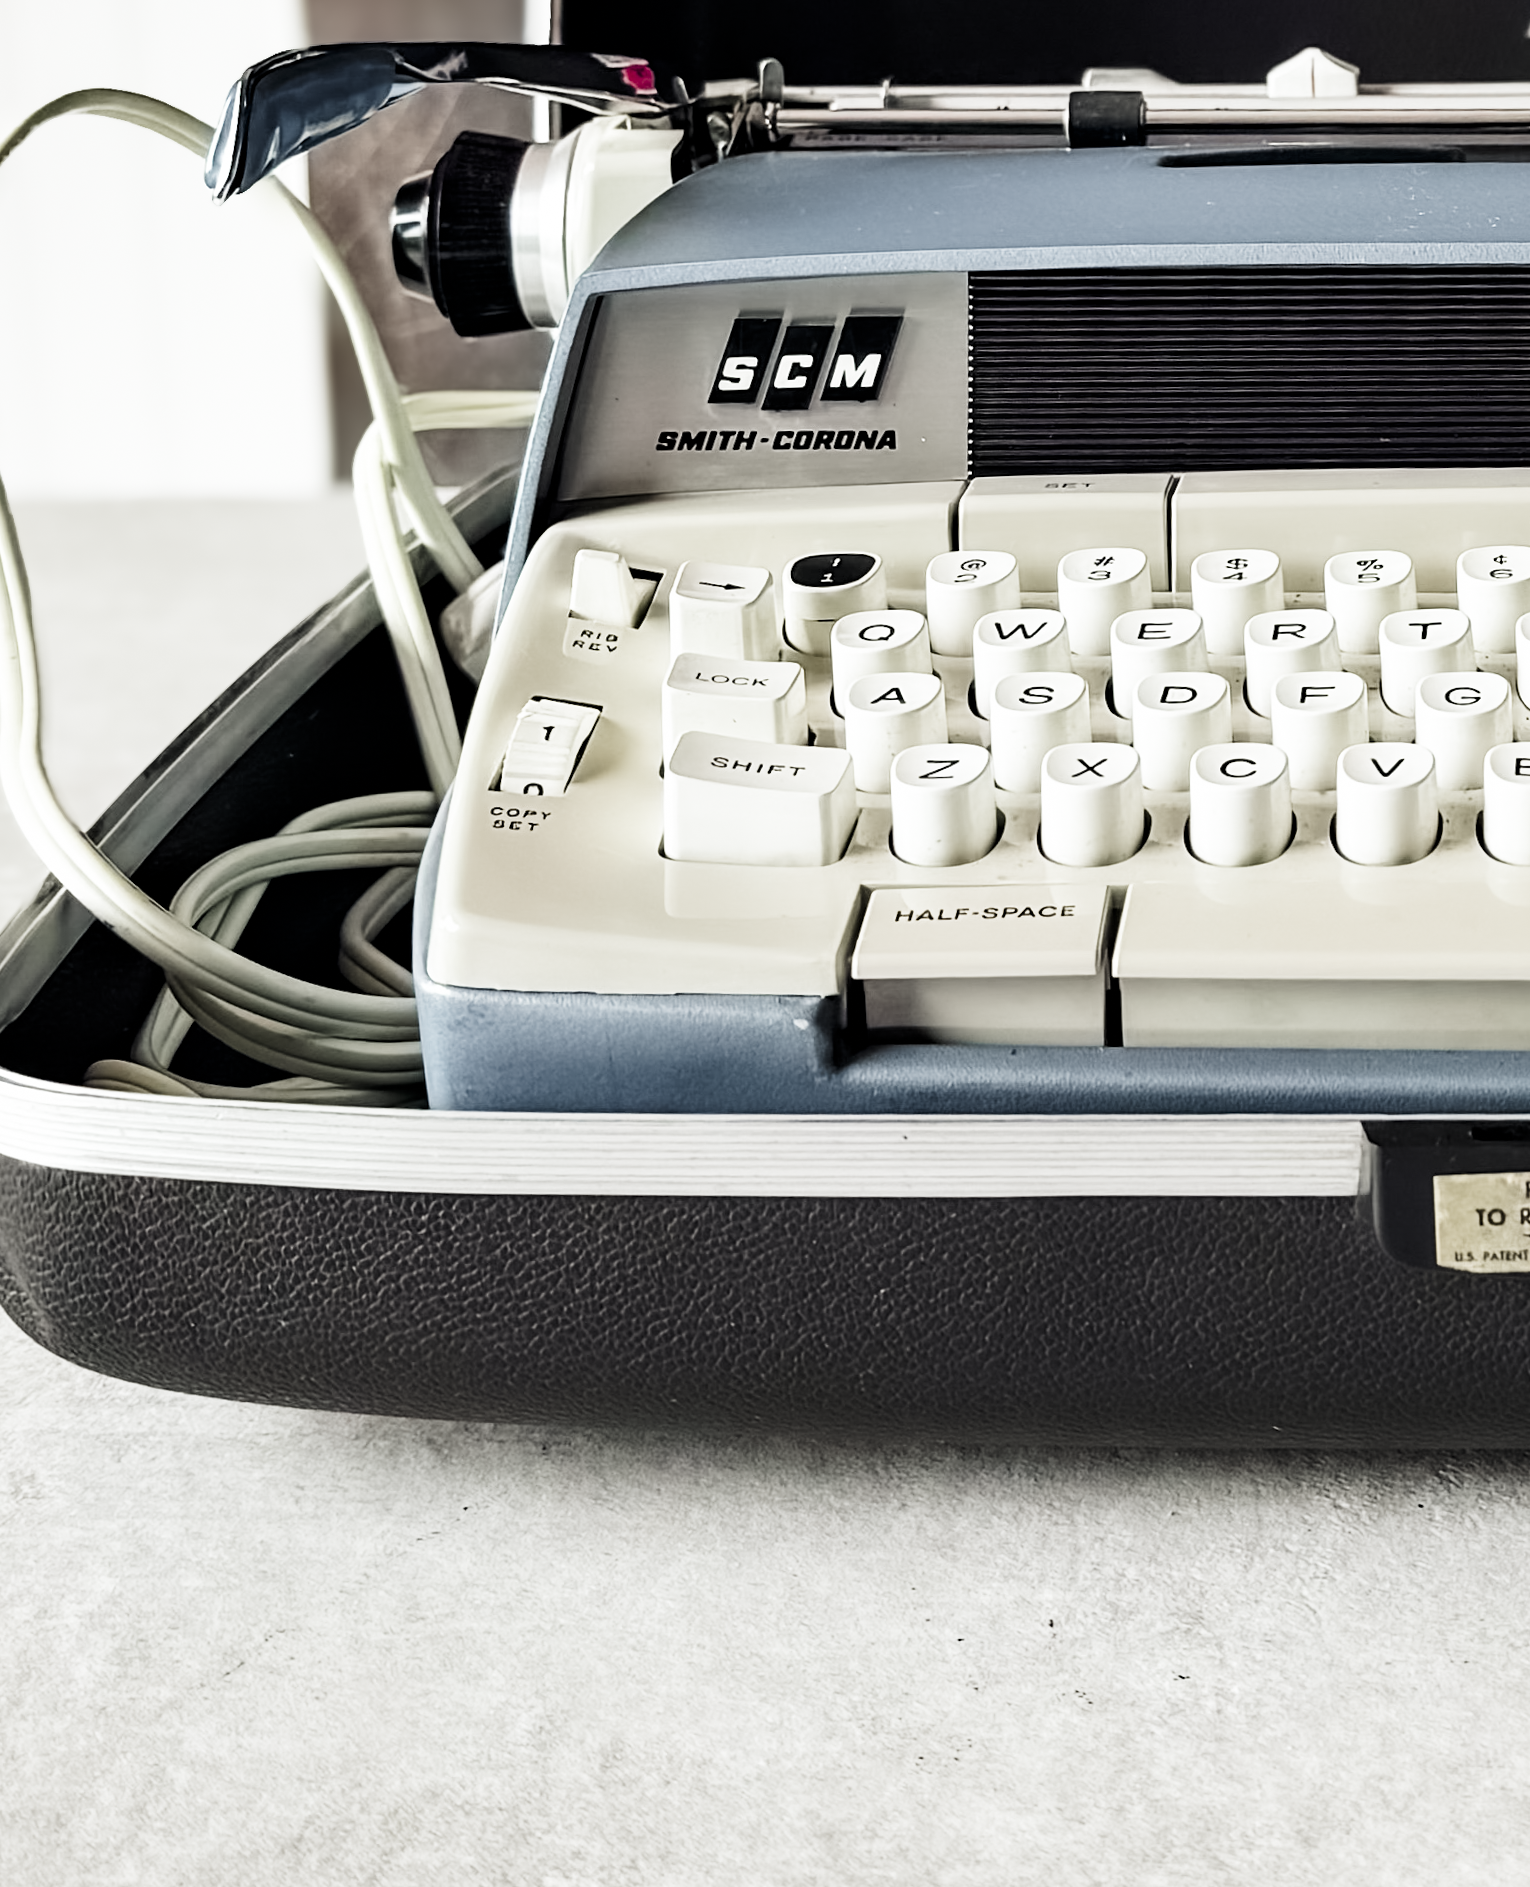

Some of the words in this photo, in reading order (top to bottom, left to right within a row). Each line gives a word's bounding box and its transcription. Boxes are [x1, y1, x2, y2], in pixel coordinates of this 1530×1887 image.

[717, 354, 882, 391] SCM
[655, 430, 896, 451] SMITH-CORONA
[1226, 559, 1248, 569] $
[1357, 559, 1383, 571] %
[821, 573, 833, 582] 1
[1088, 571, 1110, 580] 3
[1358, 574, 1380, 583] 5
[1490, 569, 1513, 578] 6
[859, 624, 895, 641] Q
[995, 622, 1048, 640] W
[1138, 623, 1172, 639] E
[1272, 624, 1306, 640] R
[1409, 622, 1442, 639] T
[573, 639, 617, 652] REV
[696, 673, 768, 686] LOCK
[871, 688, 906, 704] A
[1019, 687, 1054, 704] S
[1160, 686, 1197, 704] D
[1300, 687, 1335, 703] F
[1445, 687, 1481, 705] G
[543, 726, 555, 741] 1
[711, 757, 805, 776] SHIFT
[919, 760, 959, 779] Z
[1072, 759, 1107, 777] X
[1220, 759, 1256, 778] C
[1371, 759, 1404, 777] V
[490, 807, 551, 819] COPY
[895, 906, 1075, 922] HALF-SPACE
[1476, 1208, 1506, 1227] TO
[1483, 1249, 1529, 1261] PATENT
